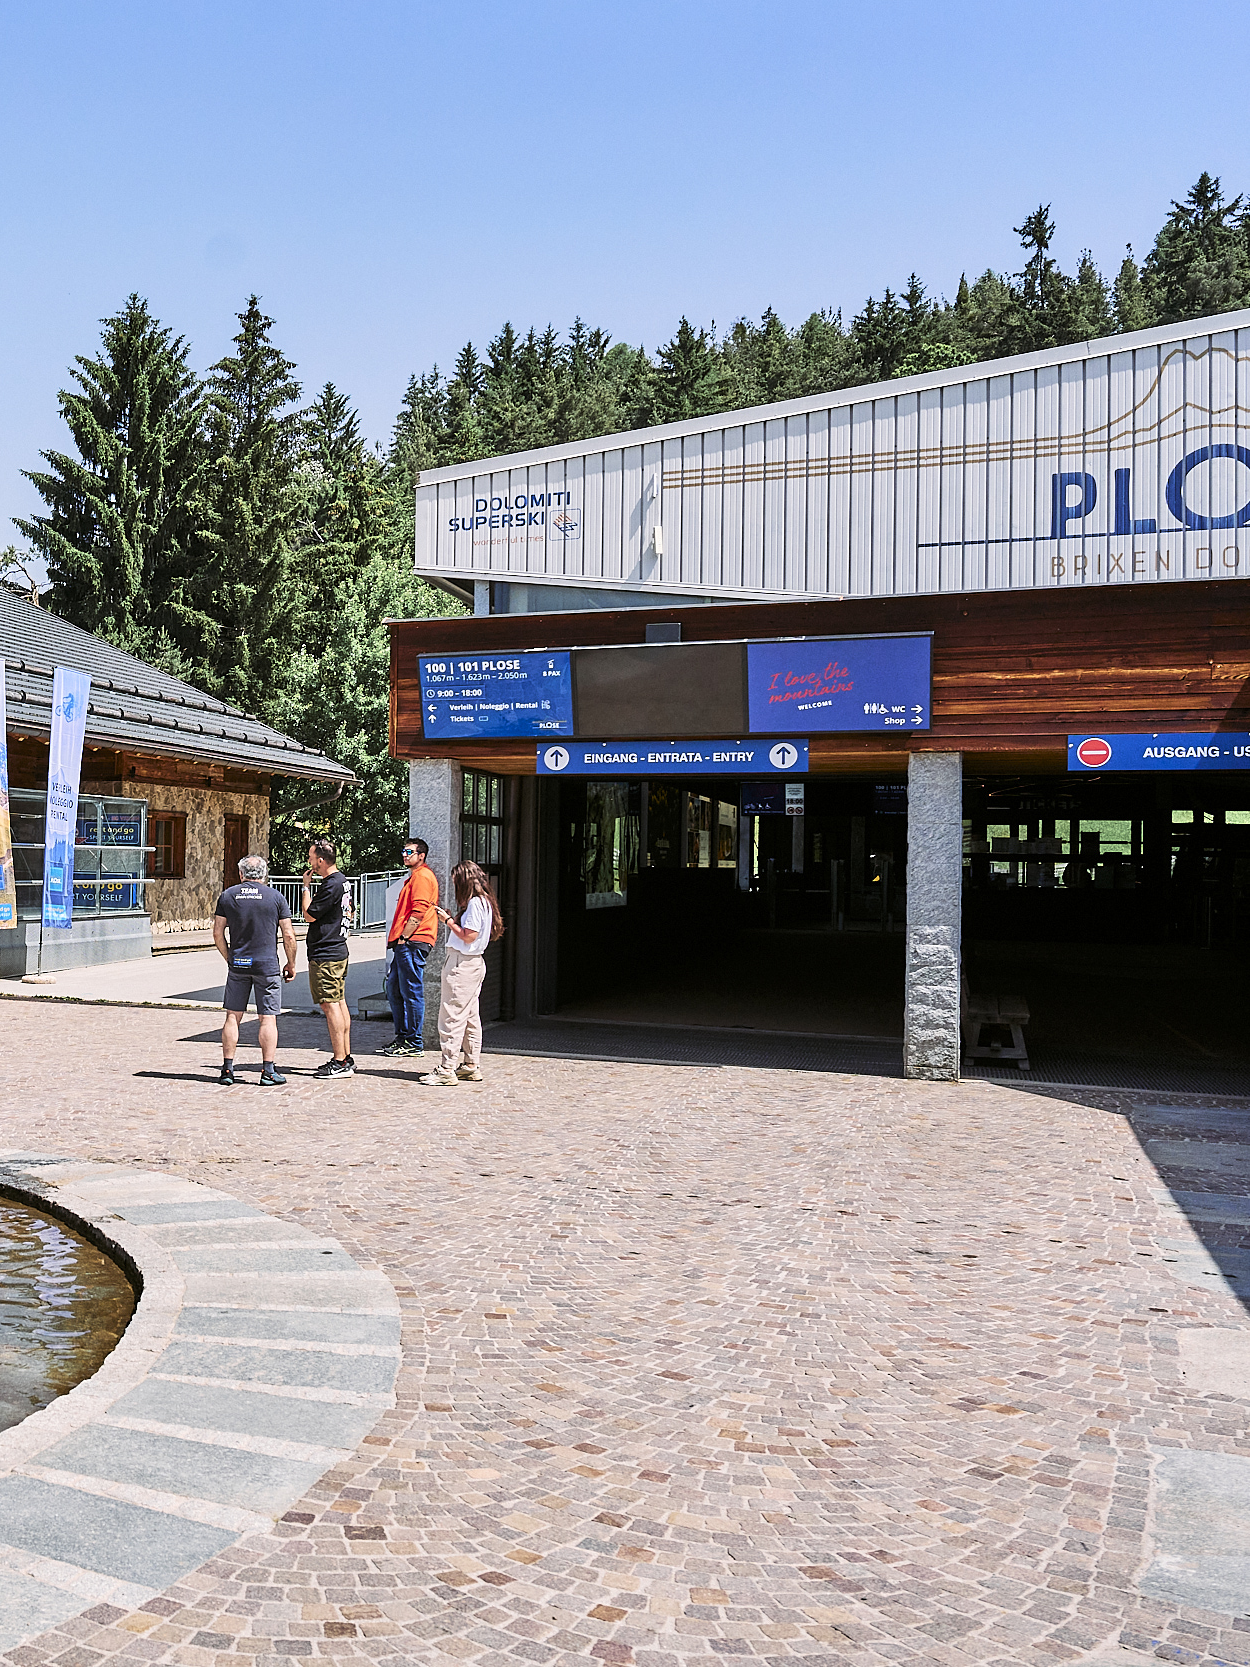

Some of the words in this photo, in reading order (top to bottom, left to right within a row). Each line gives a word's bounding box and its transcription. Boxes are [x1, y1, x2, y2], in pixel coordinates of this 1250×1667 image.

[475, 491, 571, 513] DOLOMITI
[448, 511, 545, 532] SUPERSKI
[1051, 549, 1170, 578] BRIXEN
[425, 663, 446, 673] 100
[458, 661, 478, 672] 101
[481, 659, 520, 671] PLOSE
[767, 672, 783, 691] I
[784, 670, 819, 687] love
[823, 661, 850, 680] the
[461, 689, 482, 697] 18:00
[768, 680, 854, 705] mountains
[449, 703, 473, 711] Verleih
[479, 702, 509, 711] Noleggio
[797, 700, 833, 711] WELCOME
[891, 705, 906, 713] WC
[884, 717, 906, 726] Shop
[584, 753, 638, 764] EINGANG
[647, 752, 703, 763] ENTRATA
[712, 752, 755, 762] ENTRY
[1142, 746, 1220, 758] AUSGANG
[107, 882, 123, 892] go
[82, 893, 124, 902] YORSELF
